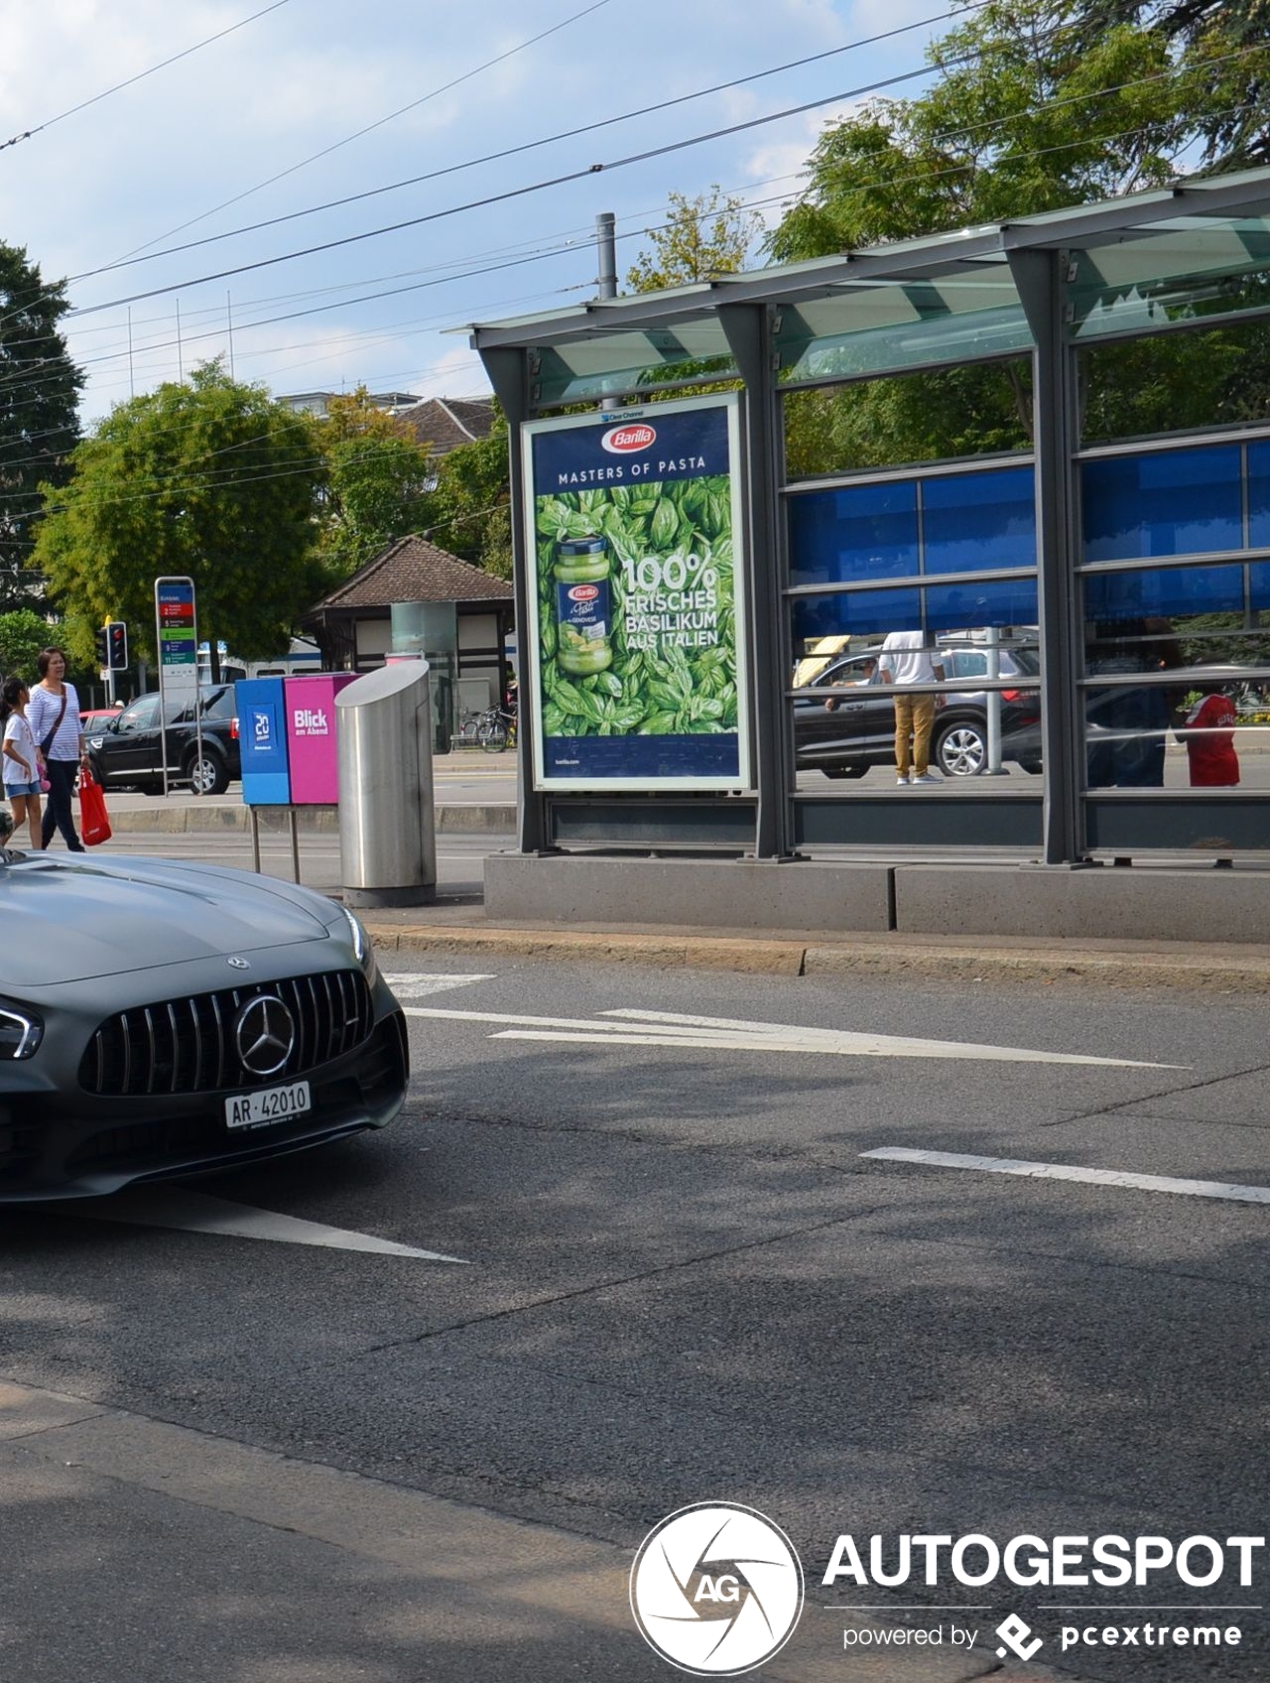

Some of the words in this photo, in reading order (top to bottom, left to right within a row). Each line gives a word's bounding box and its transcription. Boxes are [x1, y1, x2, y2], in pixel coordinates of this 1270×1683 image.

[614, 429, 652, 446] Barilla
[558, 466, 623, 485] MASTERS
[631, 463, 650, 477] OF
[658, 456, 706, 473] PASTA
[622, 551, 716, 592] 100%
[626, 590, 717, 614] FRISCHES
[626, 611, 718, 633] BASILIKUM
[626, 634, 658, 650] AUS
[661, 630, 719, 647] ITALIEN
[255, 714, 270, 735] 20
[293, 709, 328, 728] Blick
[307, 727, 329, 736] Abend
